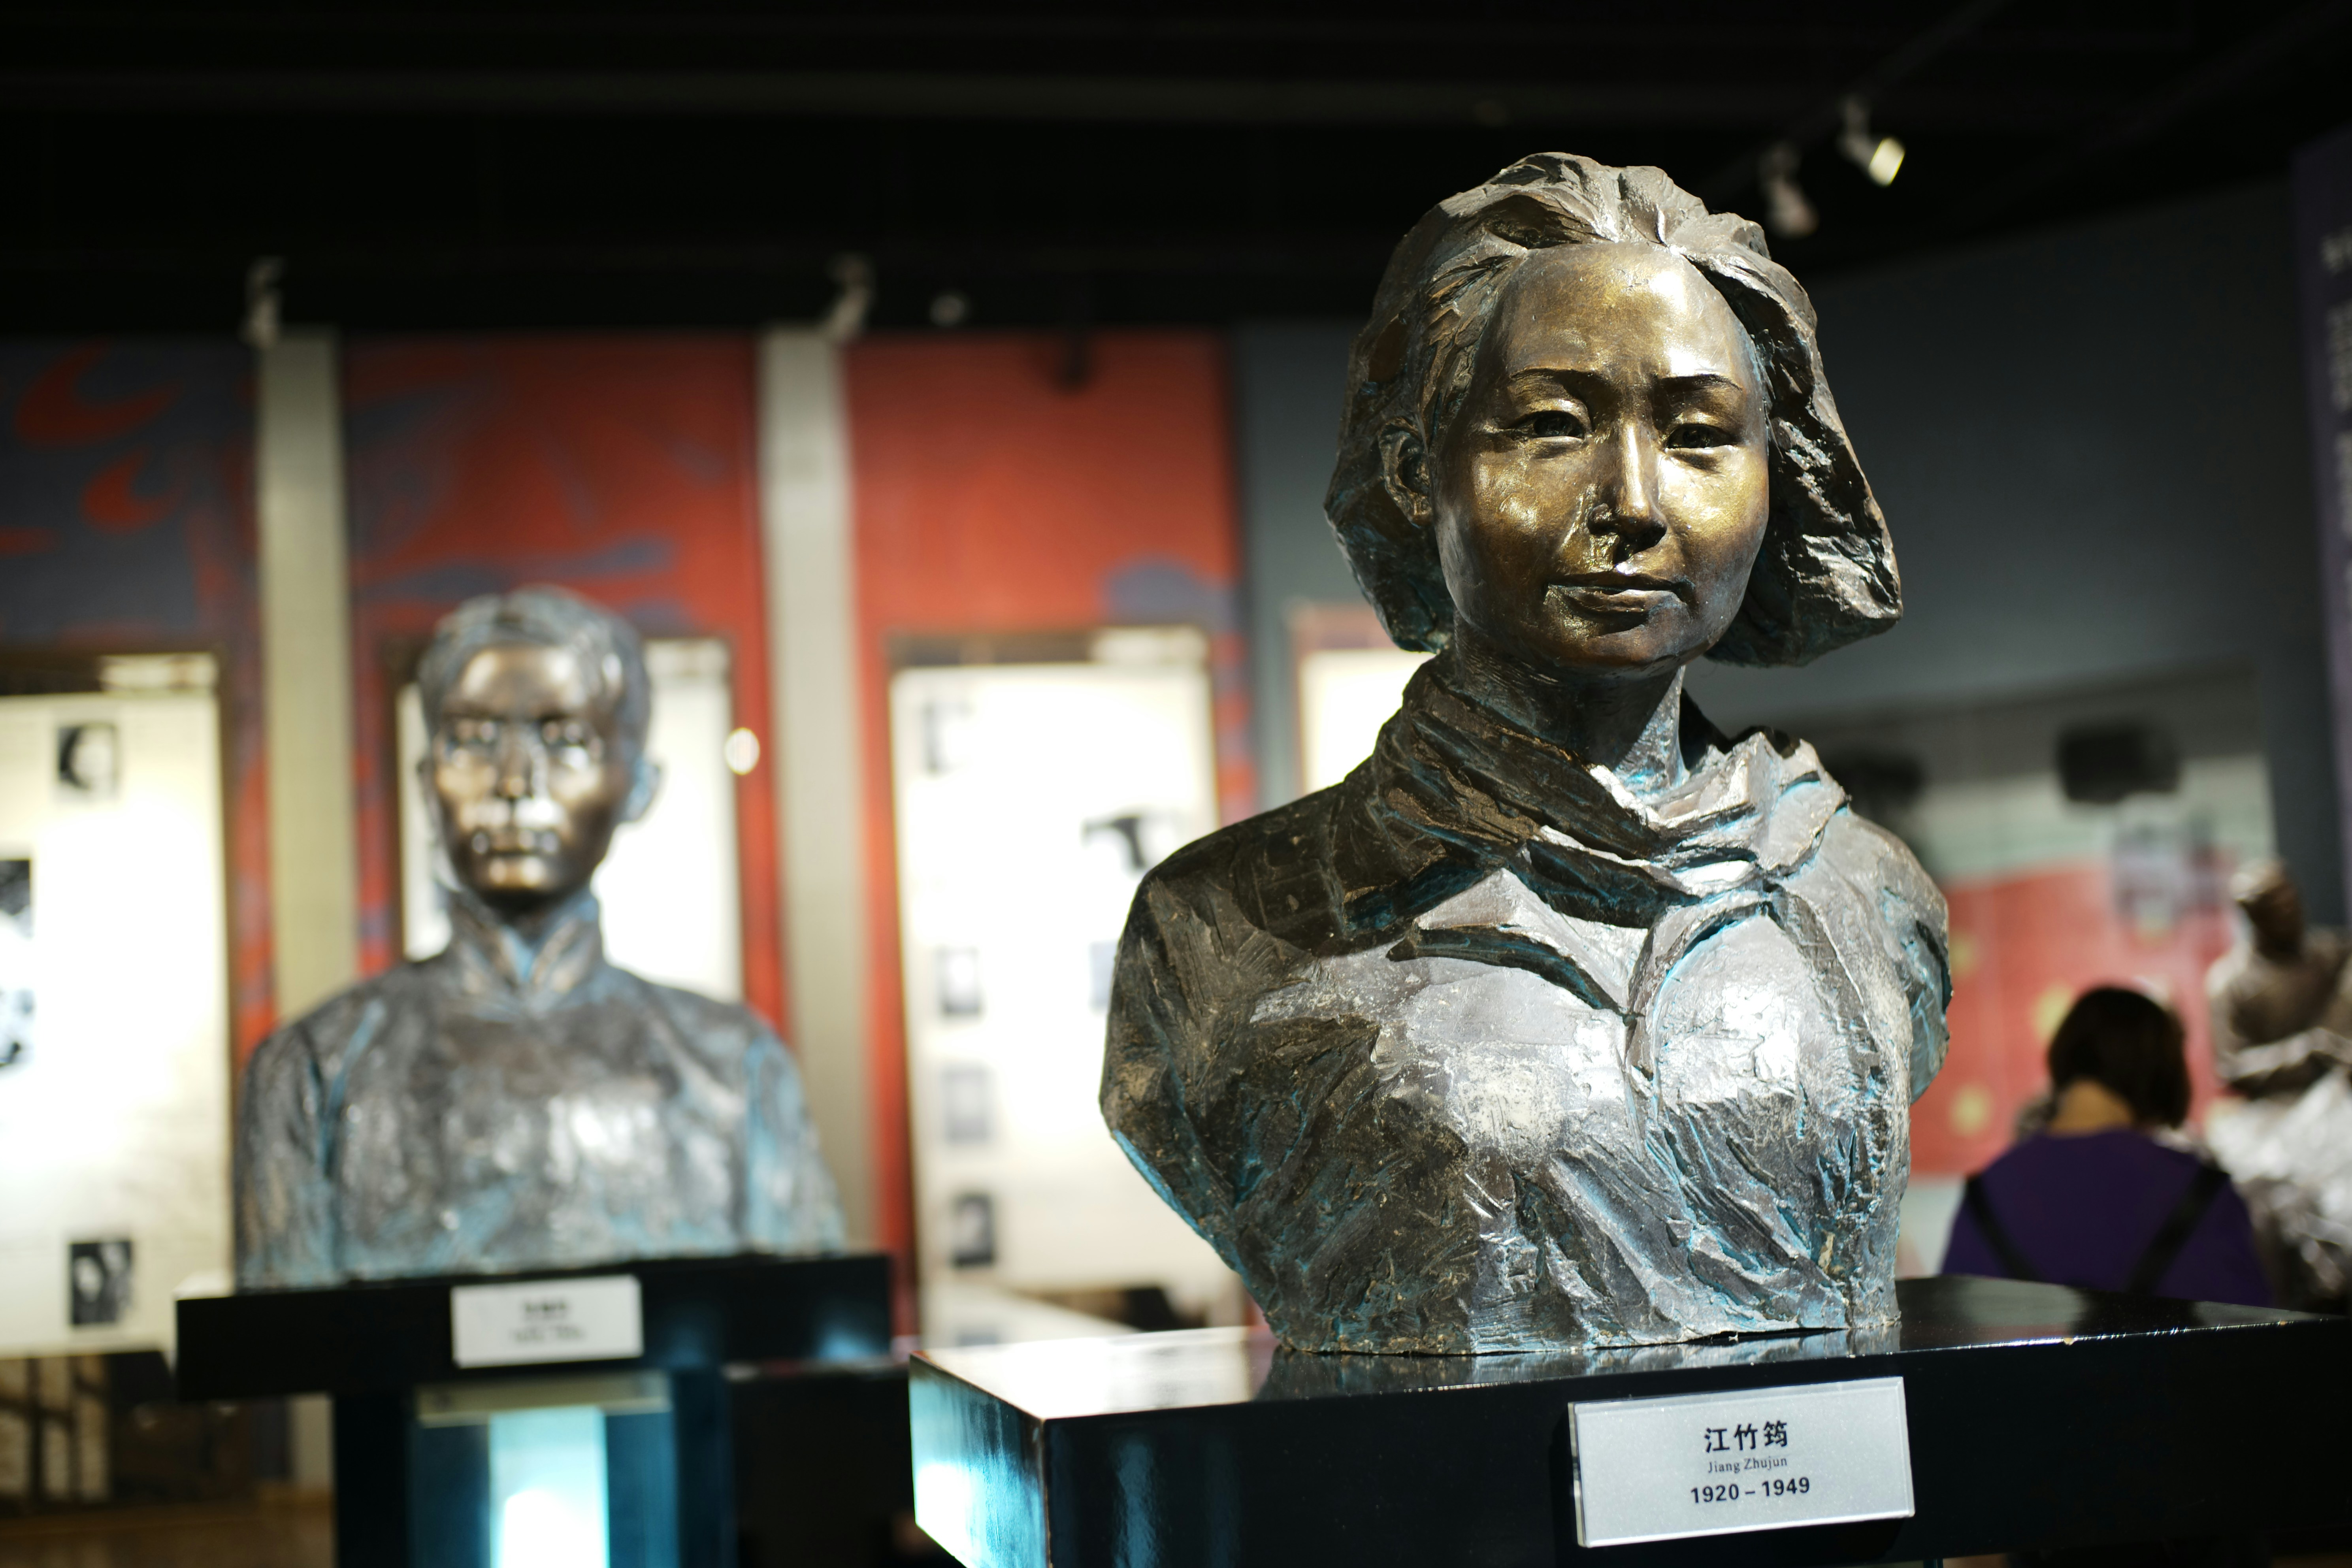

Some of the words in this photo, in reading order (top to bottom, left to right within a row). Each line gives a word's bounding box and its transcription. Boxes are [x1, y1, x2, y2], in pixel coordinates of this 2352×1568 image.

[1704, 1420, 1788, 1453] 江竹筠
[1708, 1461, 1740, 1474] Jiang
[1744, 1456, 1787, 1470] Zhujun
